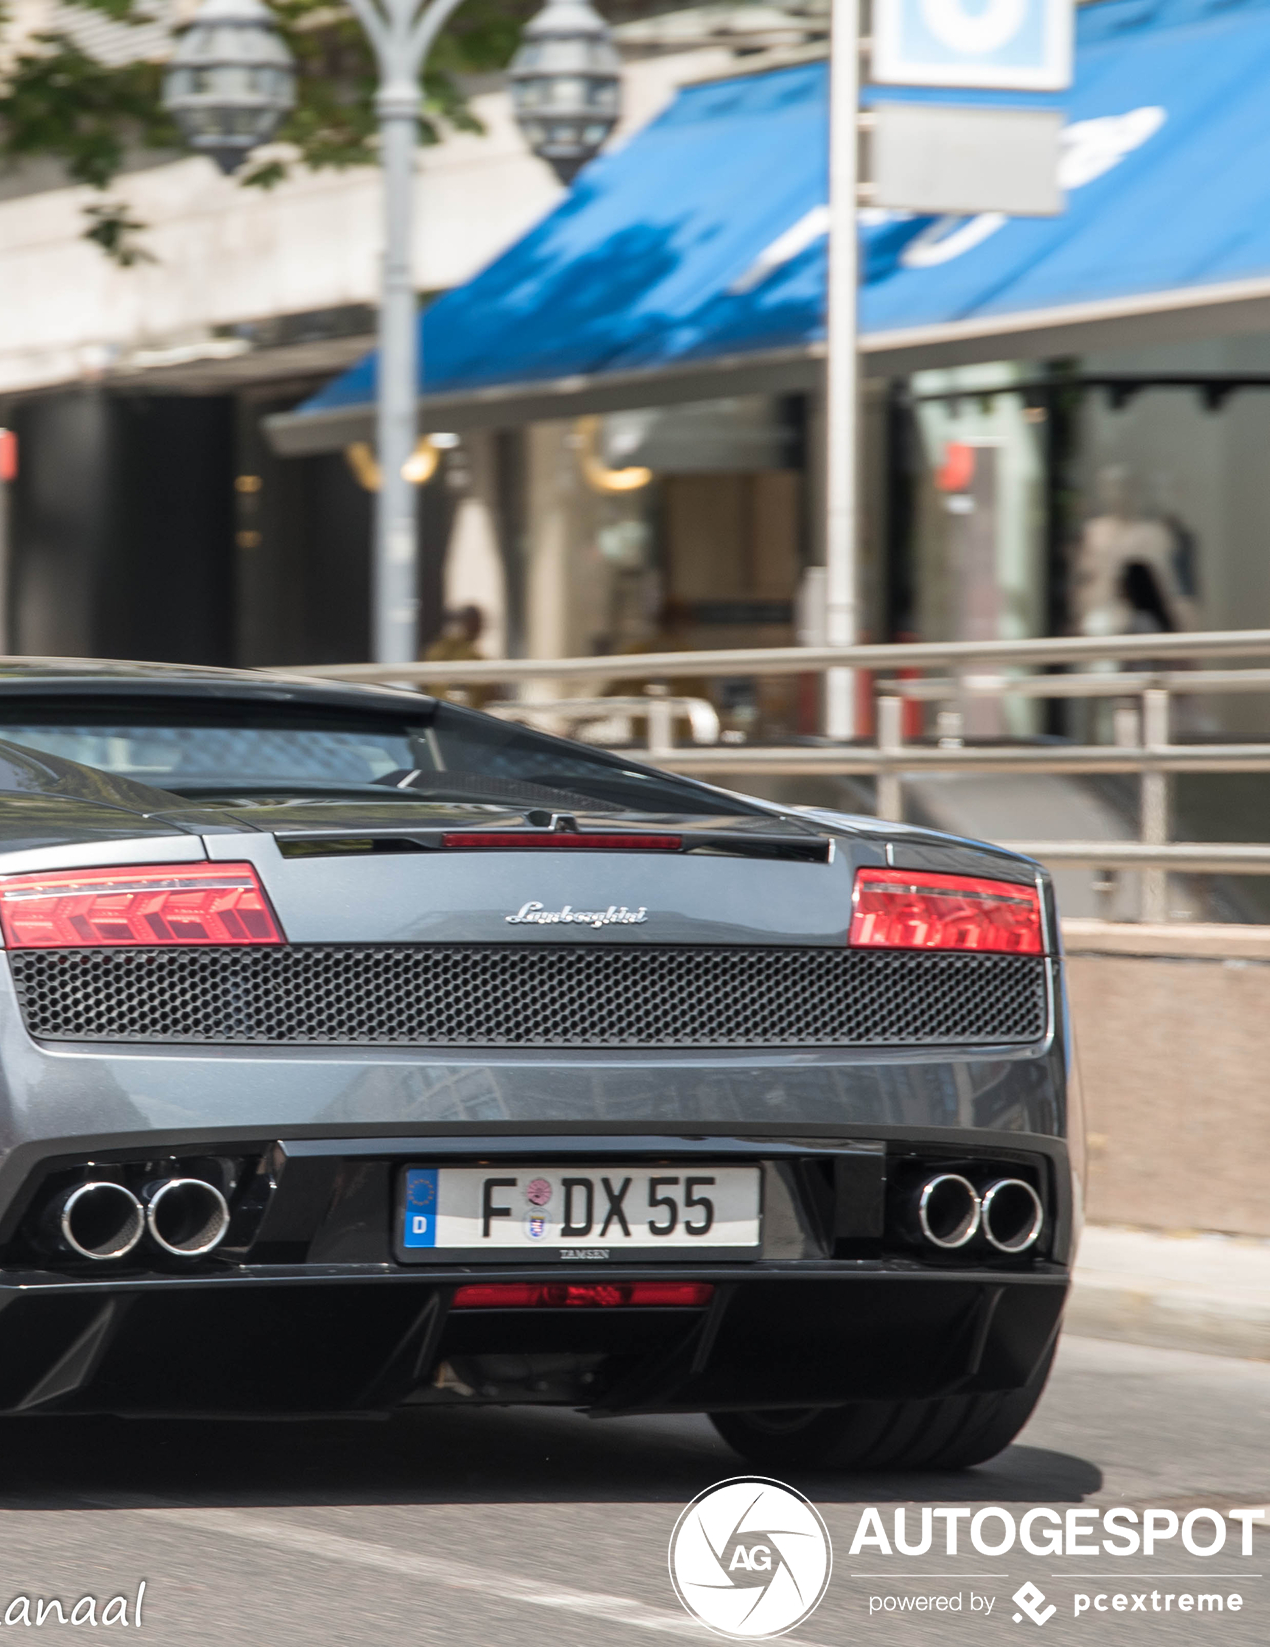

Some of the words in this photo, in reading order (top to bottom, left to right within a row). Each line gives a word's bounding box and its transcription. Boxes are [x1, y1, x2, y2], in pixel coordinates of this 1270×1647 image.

[504, 900, 649, 929] Lamborghini
[482, 1177, 518, 1238] F
[560, 1177, 633, 1238] DX
[647, 1176, 717, 1237] 55
[412, 1216, 428, 1235] D
[559, 1249, 610, 1260] TAMSEN
